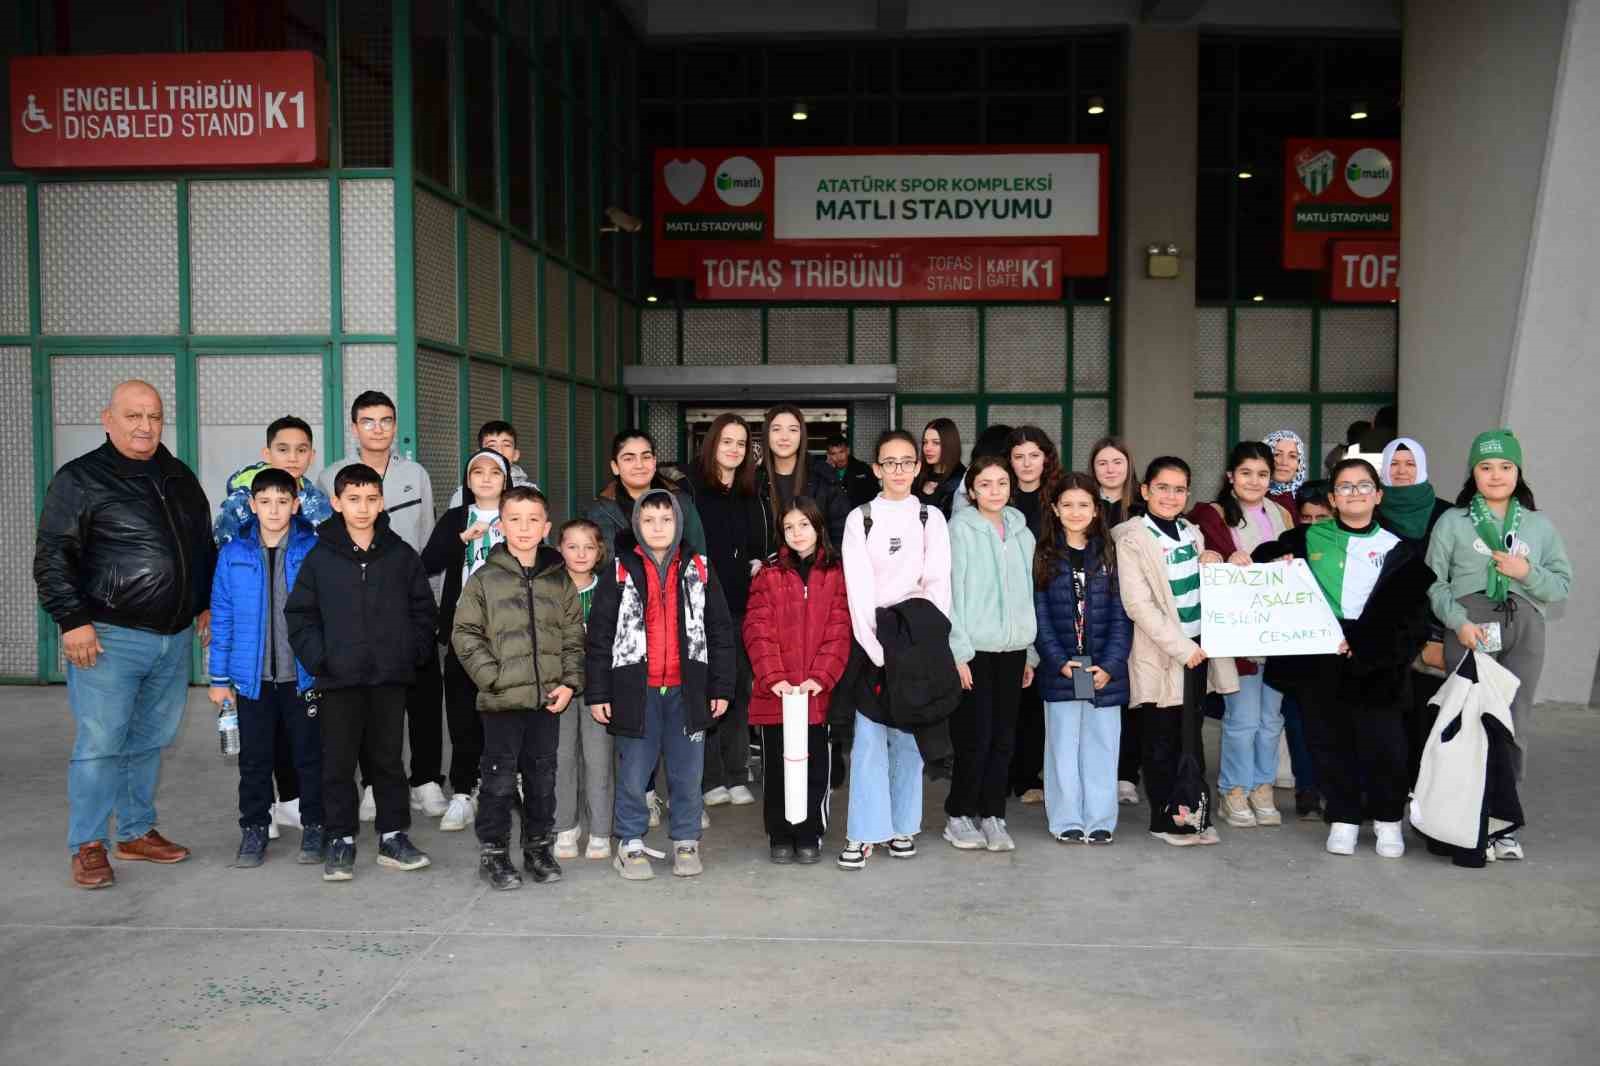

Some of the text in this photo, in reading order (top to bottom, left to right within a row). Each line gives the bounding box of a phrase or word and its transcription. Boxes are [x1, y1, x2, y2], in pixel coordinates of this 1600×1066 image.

[63, 80, 252, 111] ENGELLİ TRİBÜN
[265, 91, 305, 129] K1
[64, 112, 254, 139] DISABLED STAND
[816, 173, 1053, 193] ATATÜRK SPOR KOMPLEKSİ
[816, 198, 1053, 221] MATLI STADYUMU
[1297, 213, 1390, 223] MATLI STADYUMU
[666, 221, 763, 232] MATLI STADYUMU
[702, 253, 903, 291] TOFAŞ TRİBÜNÜ
[986, 259, 1019, 273] KAPI
[1022, 258, 1055, 288] K1
[1342, 254, 1400, 288] TOF
[927, 275, 973, 291] STAND
[986, 274, 1020, 288] GATE
